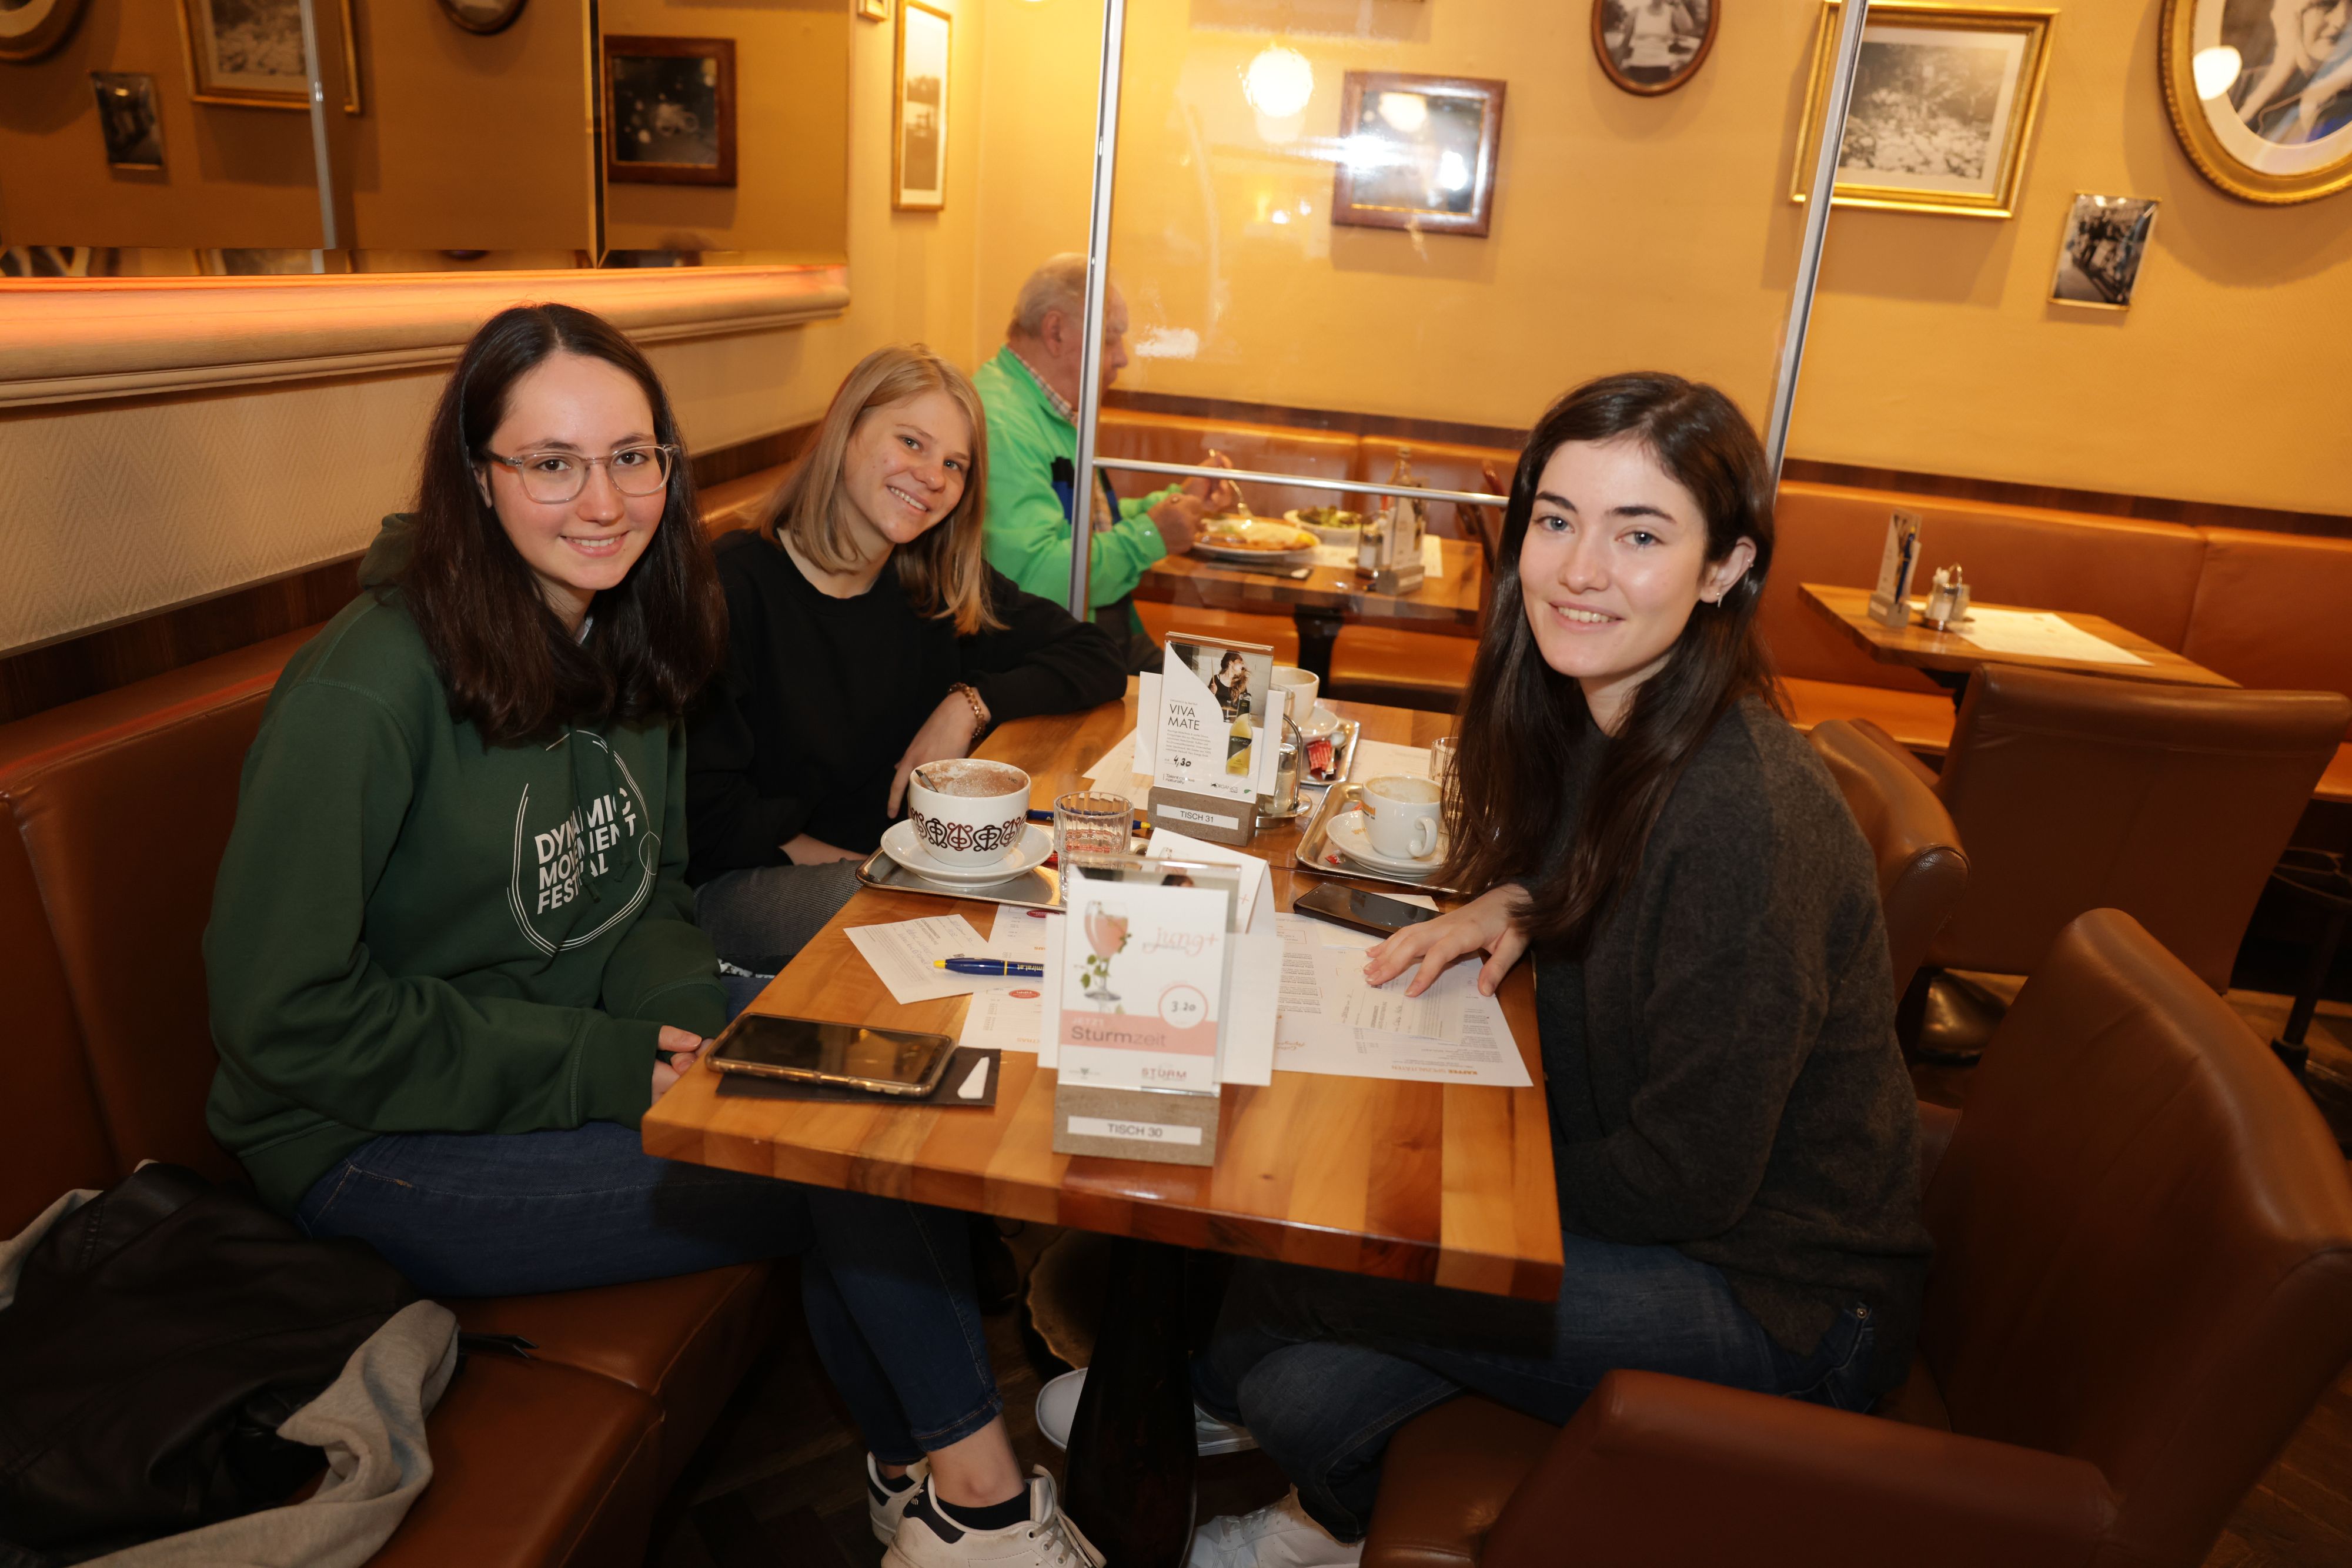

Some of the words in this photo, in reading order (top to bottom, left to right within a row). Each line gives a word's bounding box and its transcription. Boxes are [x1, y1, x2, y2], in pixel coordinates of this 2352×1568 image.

[1170, 704, 1195, 717] VIVA
[1168, 717, 1200, 730] MATE
[1174, 755, 1191, 767] 4,30
[1180, 811, 1203, 821] TISCH
[534, 787, 631, 864] DYNAMIC
[1071, 1026, 1167, 1047] Sturmzeit
[1108, 1123, 1145, 1136] TISCH
[1148, 1127, 1163, 1138] 30
